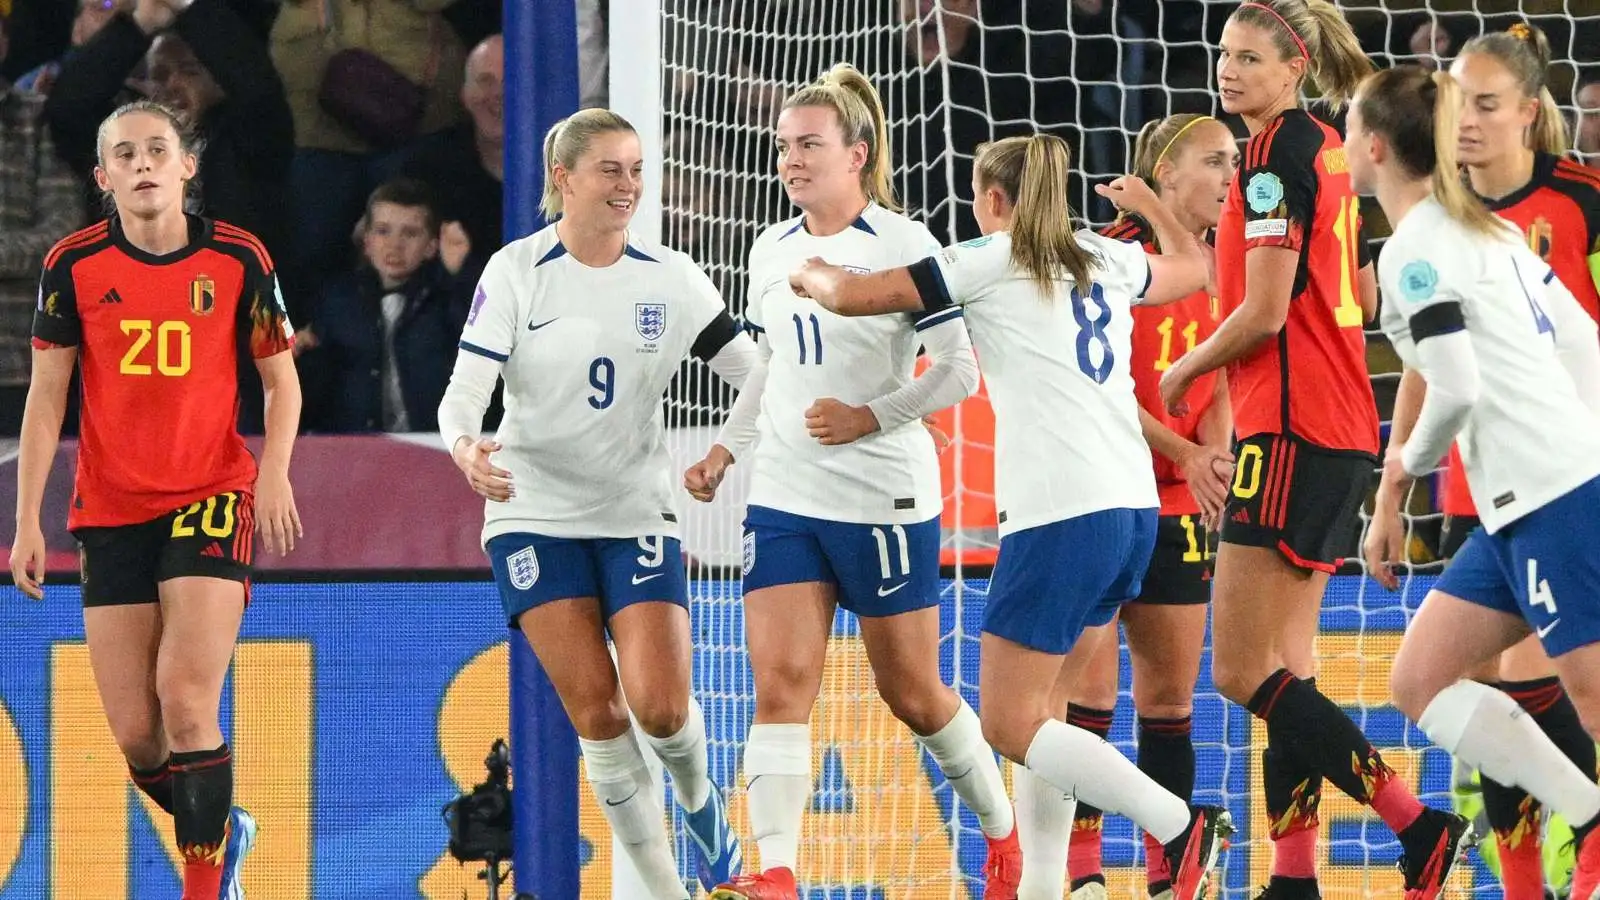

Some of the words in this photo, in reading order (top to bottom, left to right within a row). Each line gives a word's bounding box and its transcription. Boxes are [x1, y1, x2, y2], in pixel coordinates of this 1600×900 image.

[120, 319, 191, 376] 20
[792, 313, 822, 365] 11
[1070, 281, 1114, 385] 8
[1153, 316, 1199, 371] 11
[587, 357, 615, 409] 9
[171, 488, 237, 538] 20
[637, 534, 664, 568] 9
[872, 525, 910, 579] 11
[1527, 559, 1557, 613] 4
[0, 638, 314, 900] N
